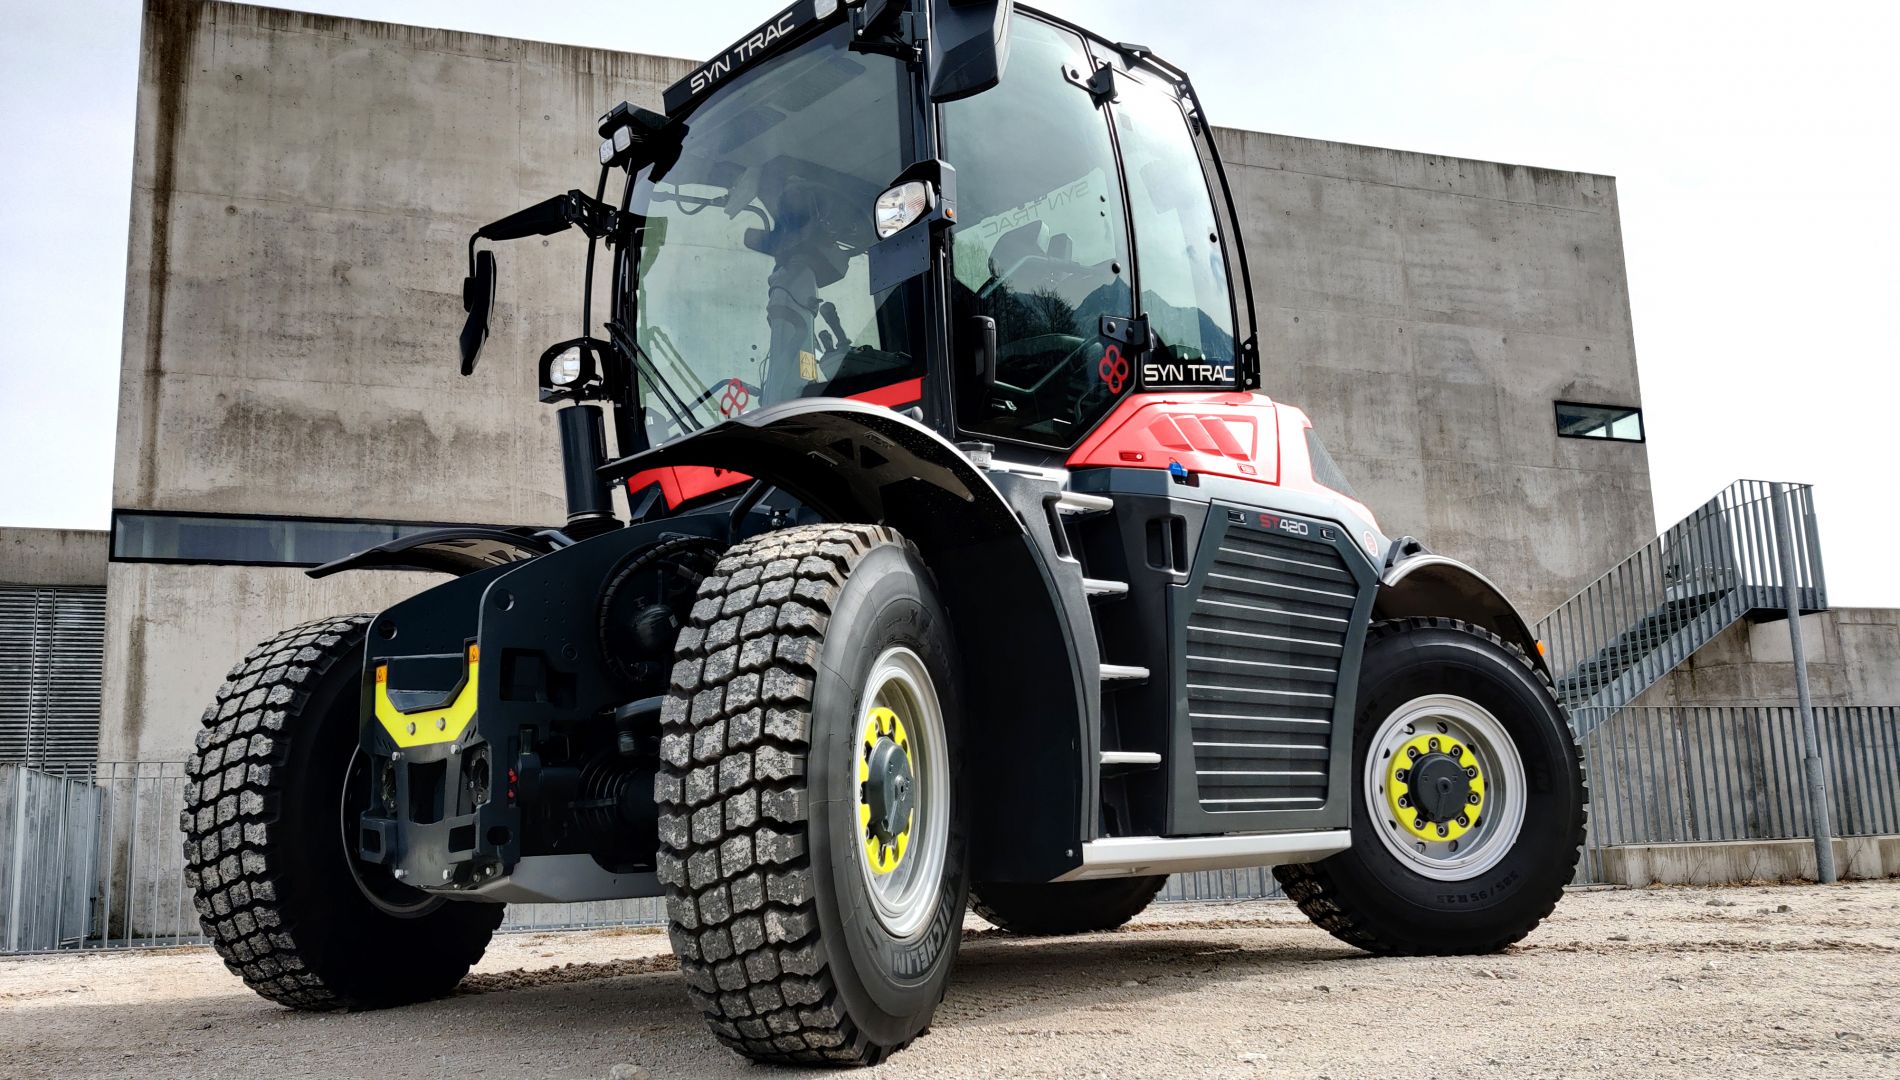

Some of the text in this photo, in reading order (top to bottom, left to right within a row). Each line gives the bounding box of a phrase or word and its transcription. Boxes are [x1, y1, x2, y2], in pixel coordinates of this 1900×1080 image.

[690, 11, 795, 95] SYN TRAC
[1144, 364, 1236, 382] SYN TRAC
[1259, 513, 1309, 536] ST420
[893, 880, 956, 976] MICHELIN
